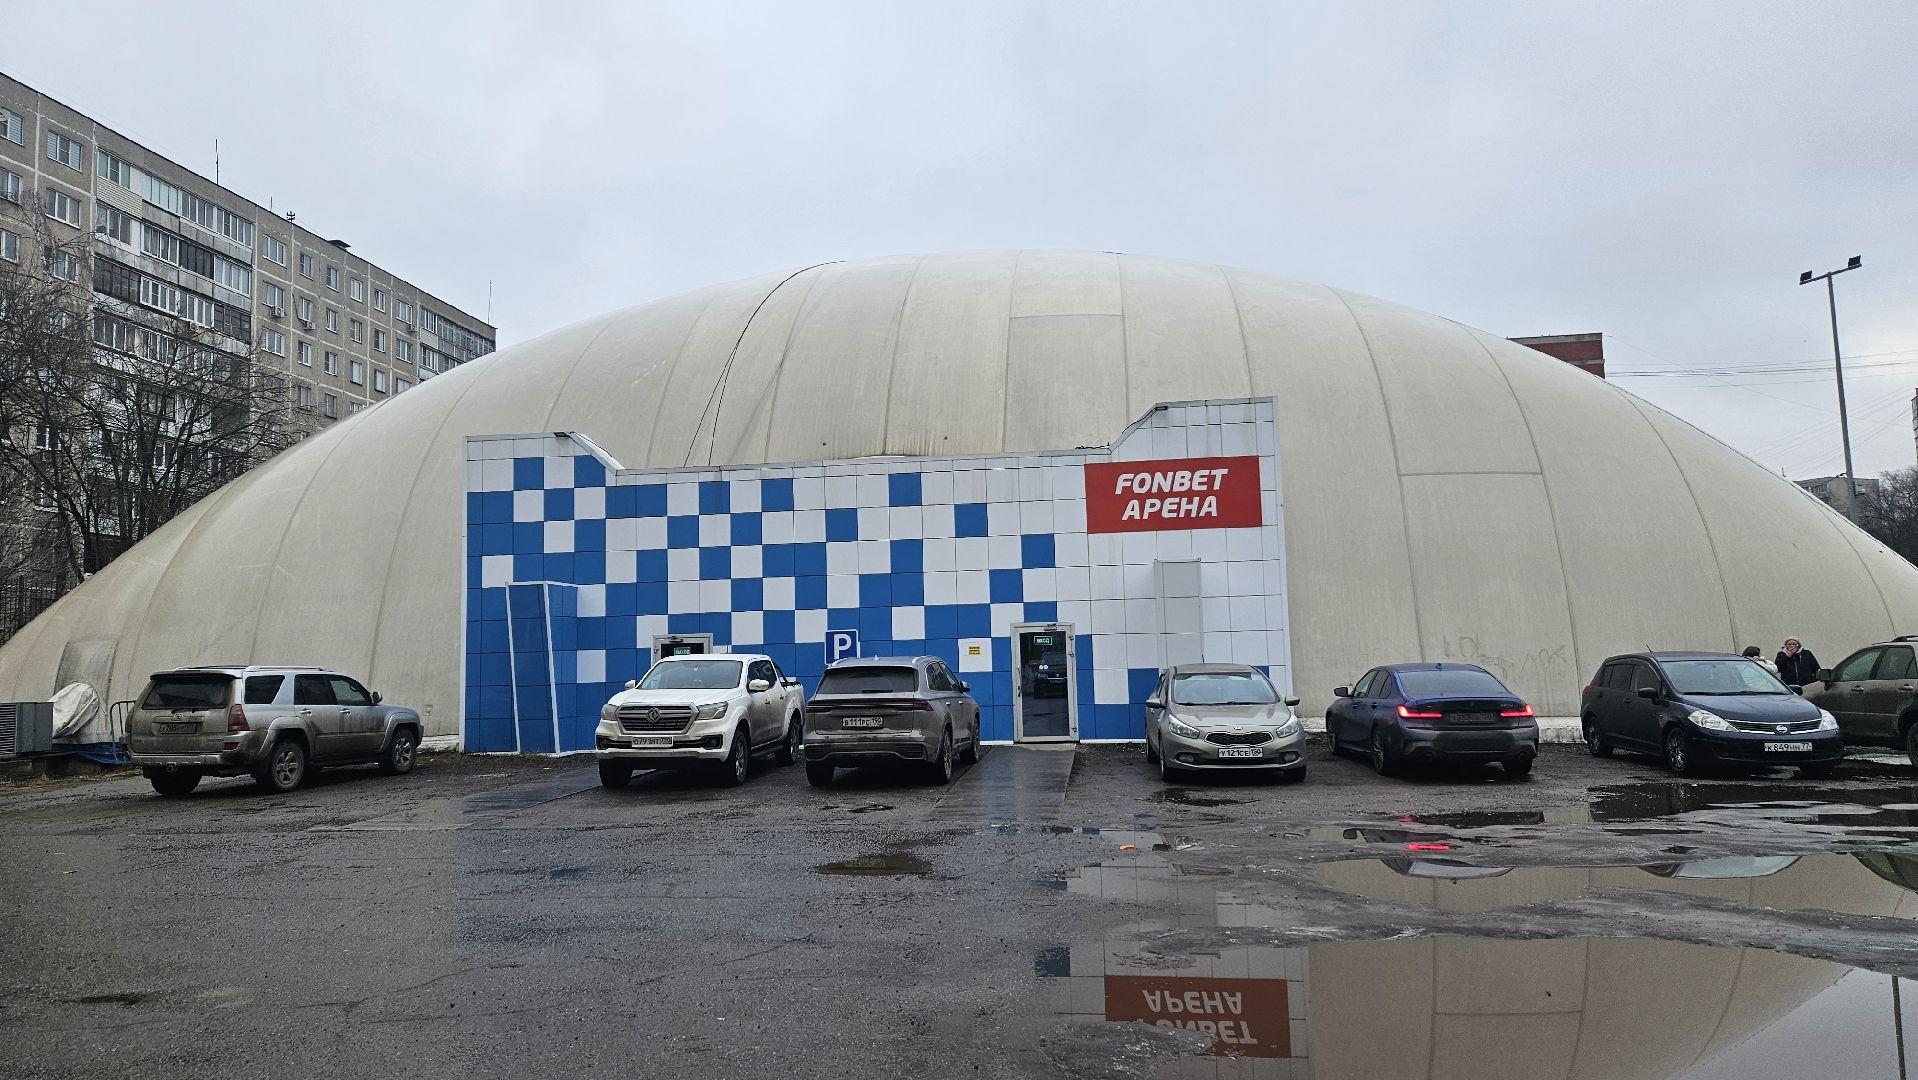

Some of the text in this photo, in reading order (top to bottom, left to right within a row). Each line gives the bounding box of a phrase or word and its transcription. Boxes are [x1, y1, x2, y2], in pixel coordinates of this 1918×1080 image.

[1114, 468, 1229, 495] FONBET
[1121, 495, 1218, 521] АРЕНА
[833, 633, 852, 660] P
